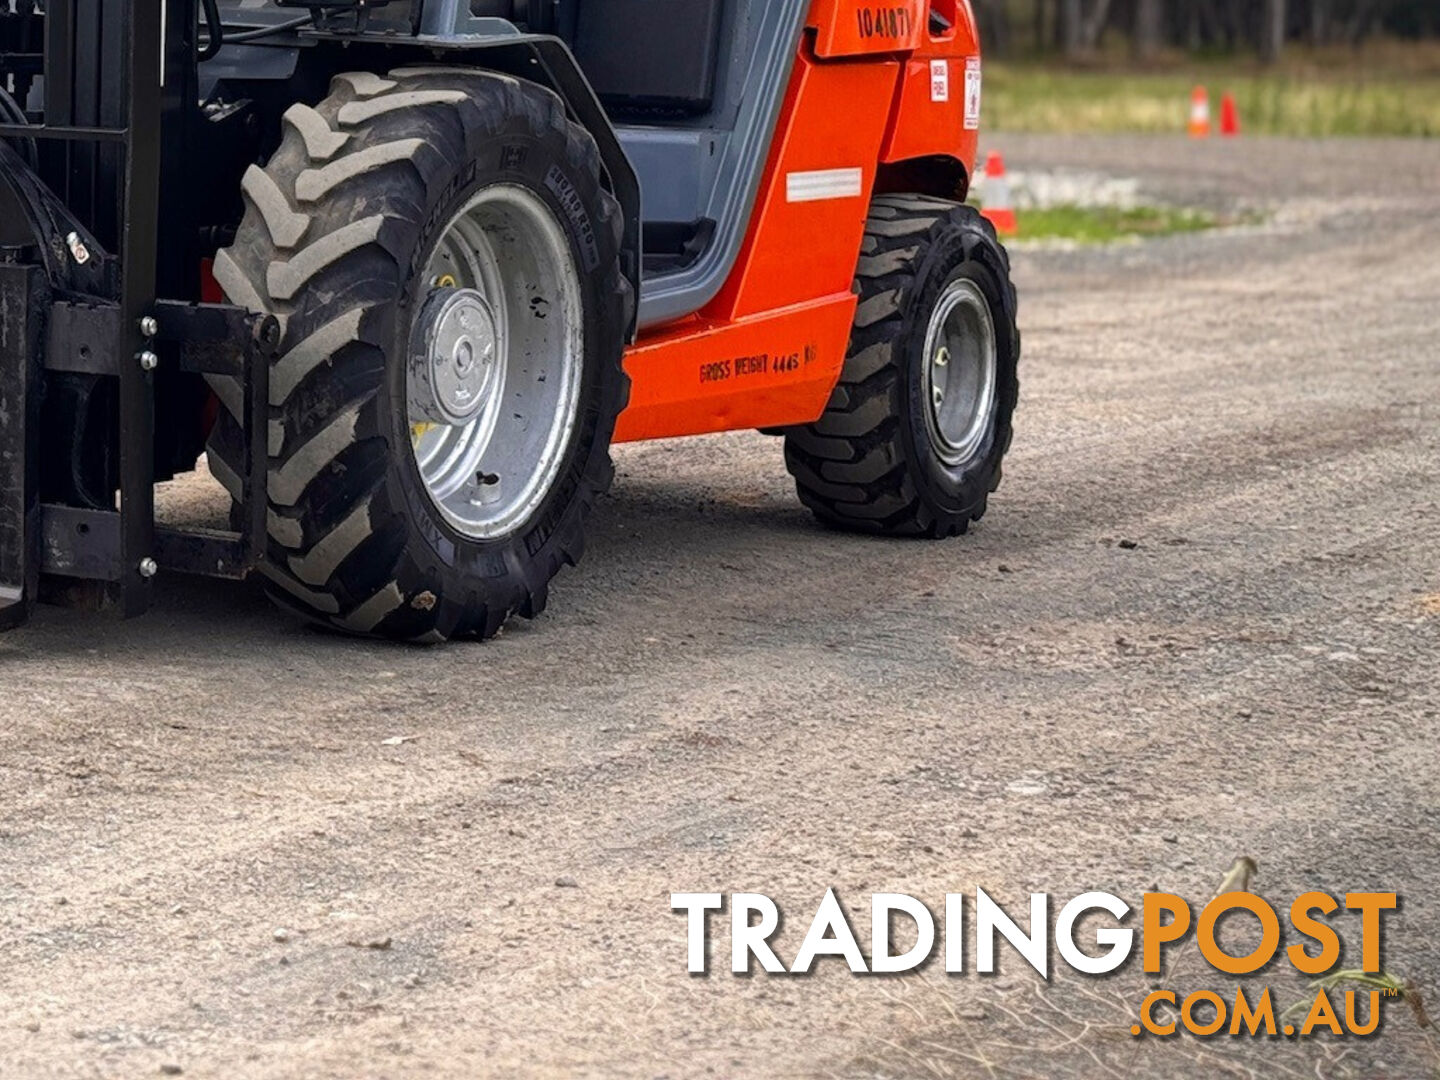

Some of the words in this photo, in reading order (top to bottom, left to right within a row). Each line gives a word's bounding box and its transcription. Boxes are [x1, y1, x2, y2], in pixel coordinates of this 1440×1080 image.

[857, 7, 911, 39] 1041871
[699, 359, 731, 384] GROSS
[734, 353, 768, 378] WEIGHT
